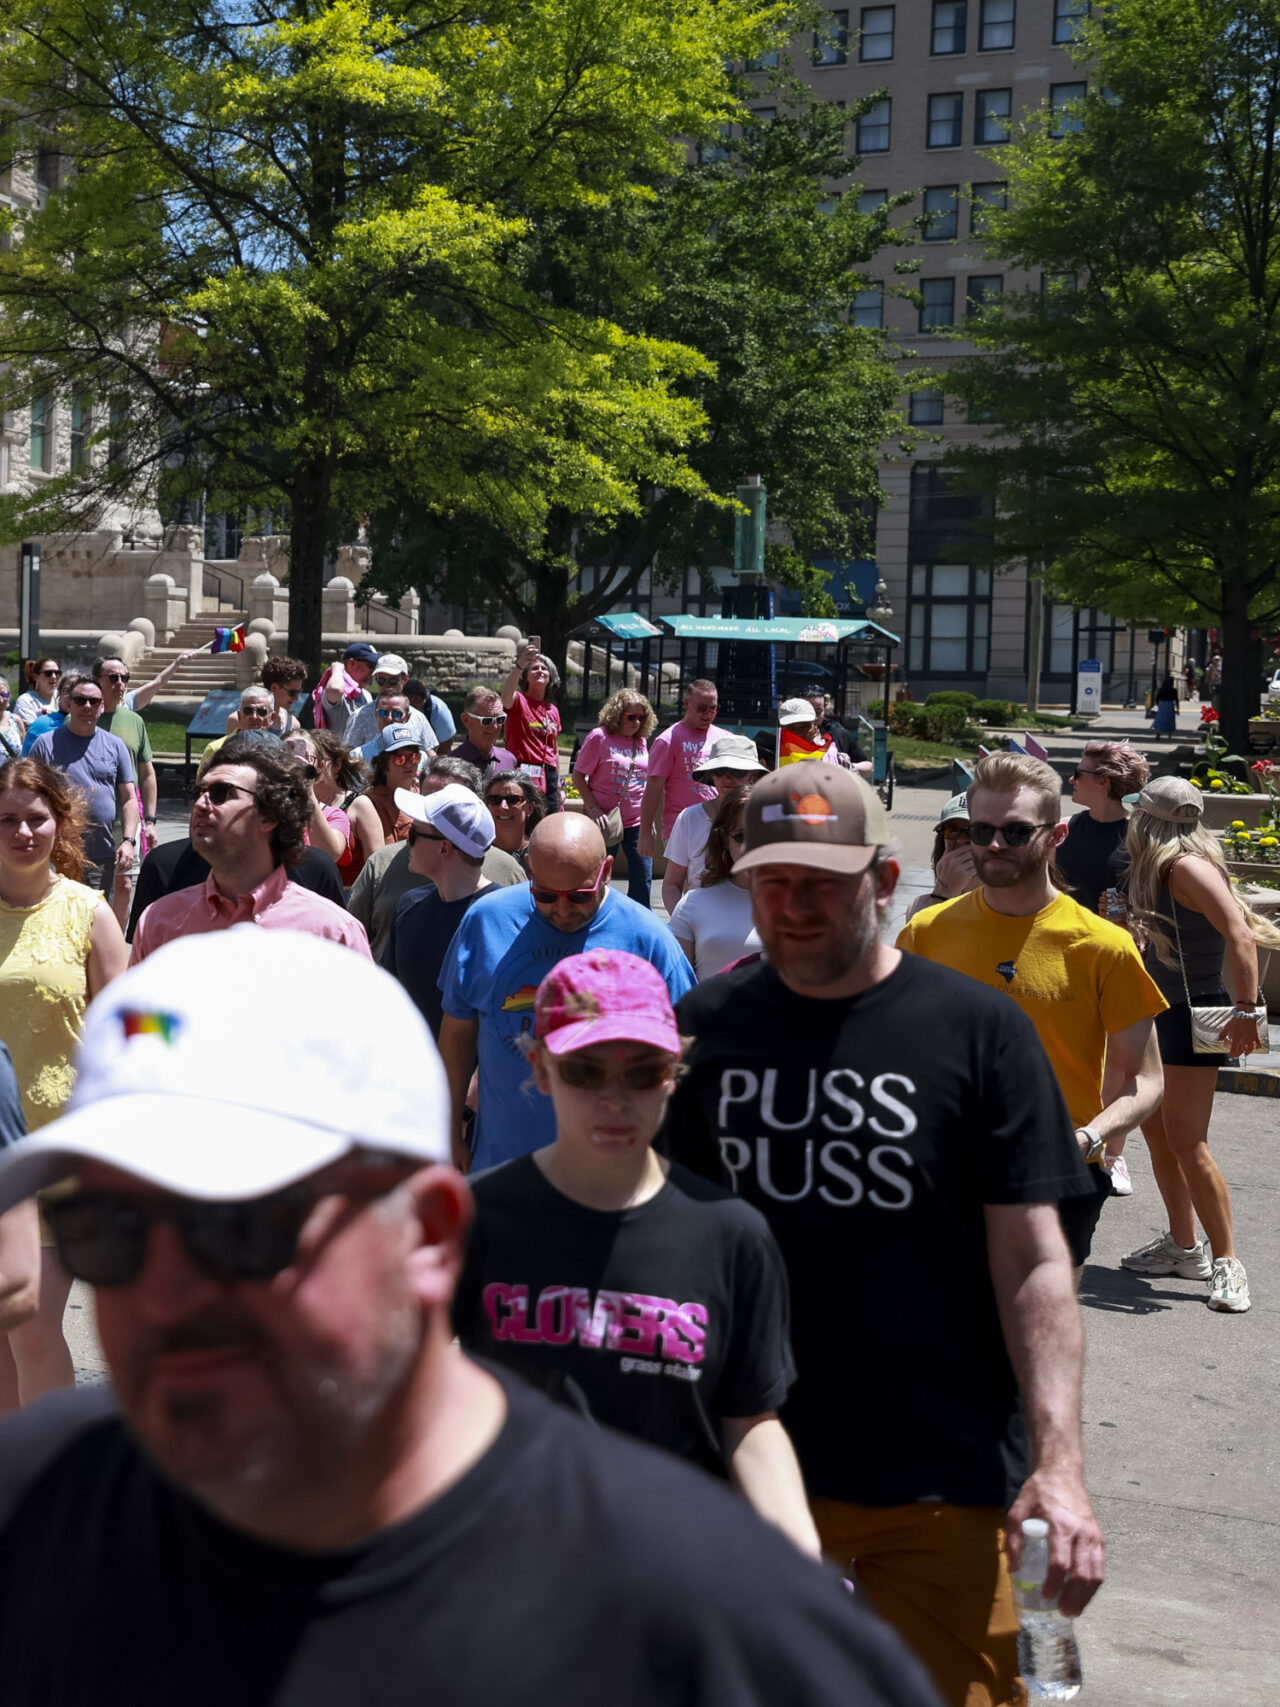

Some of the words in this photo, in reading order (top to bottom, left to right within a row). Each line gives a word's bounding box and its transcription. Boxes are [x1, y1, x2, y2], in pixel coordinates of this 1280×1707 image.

[695, 624, 740, 632] HANDMADE
[718, 1067, 919, 1139] PUSS
[718, 1136, 915, 1211] PUSS
[483, 1282, 710, 1364] CLOVERS
[619, 1356, 663, 1375] grass
